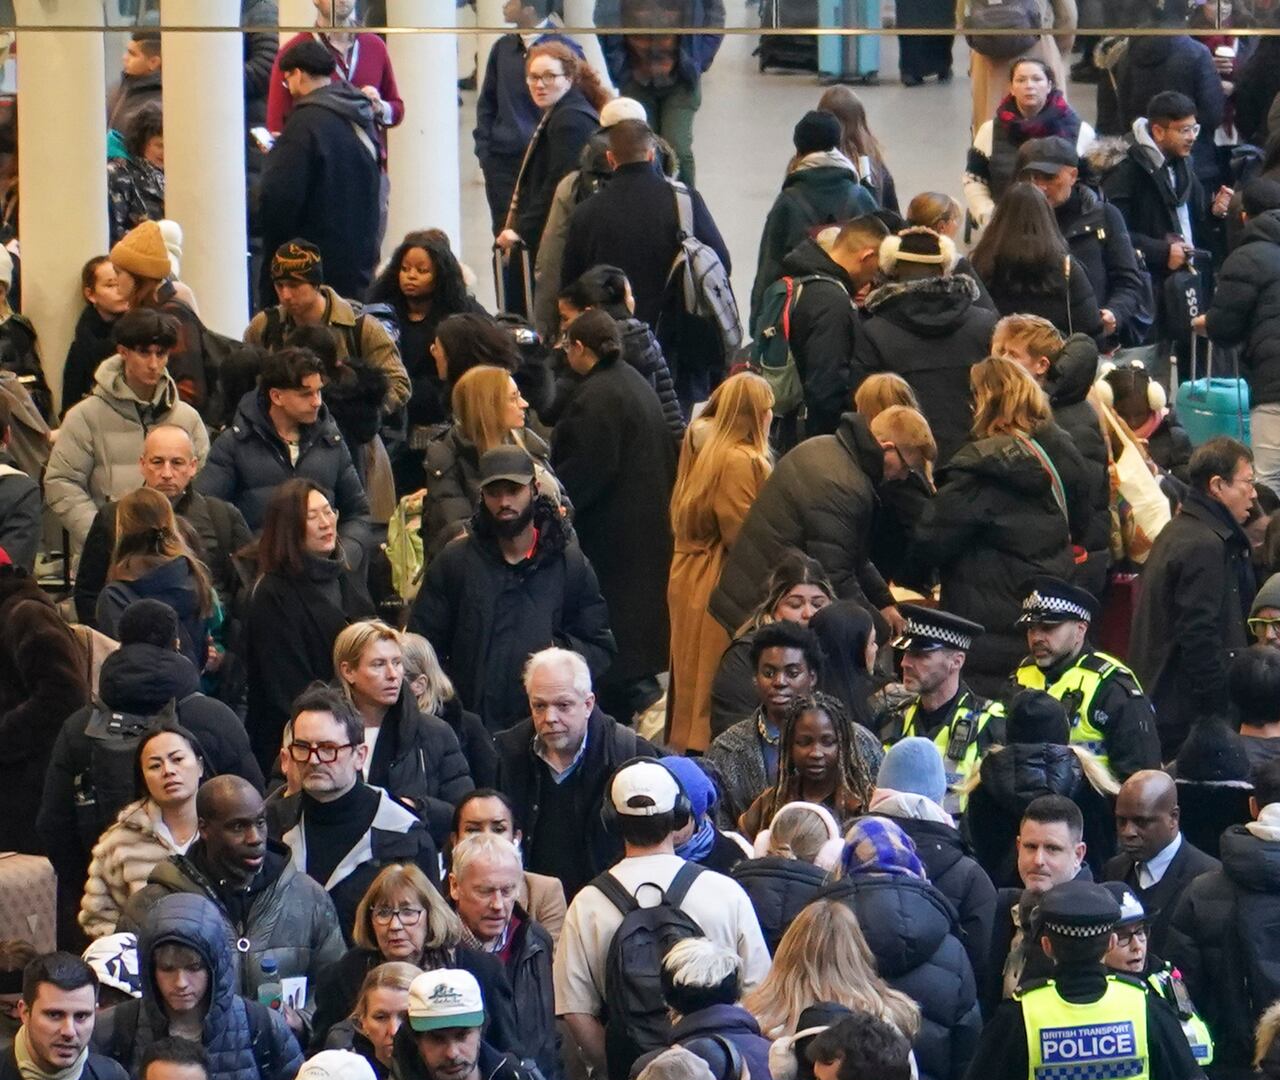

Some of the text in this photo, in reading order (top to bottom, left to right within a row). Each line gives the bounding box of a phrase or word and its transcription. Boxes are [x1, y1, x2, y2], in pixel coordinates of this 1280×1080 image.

[1042, 1024, 1130, 1039] BRITISH TRANSPORT
[1043, 1034, 1132, 1059] POLICE
